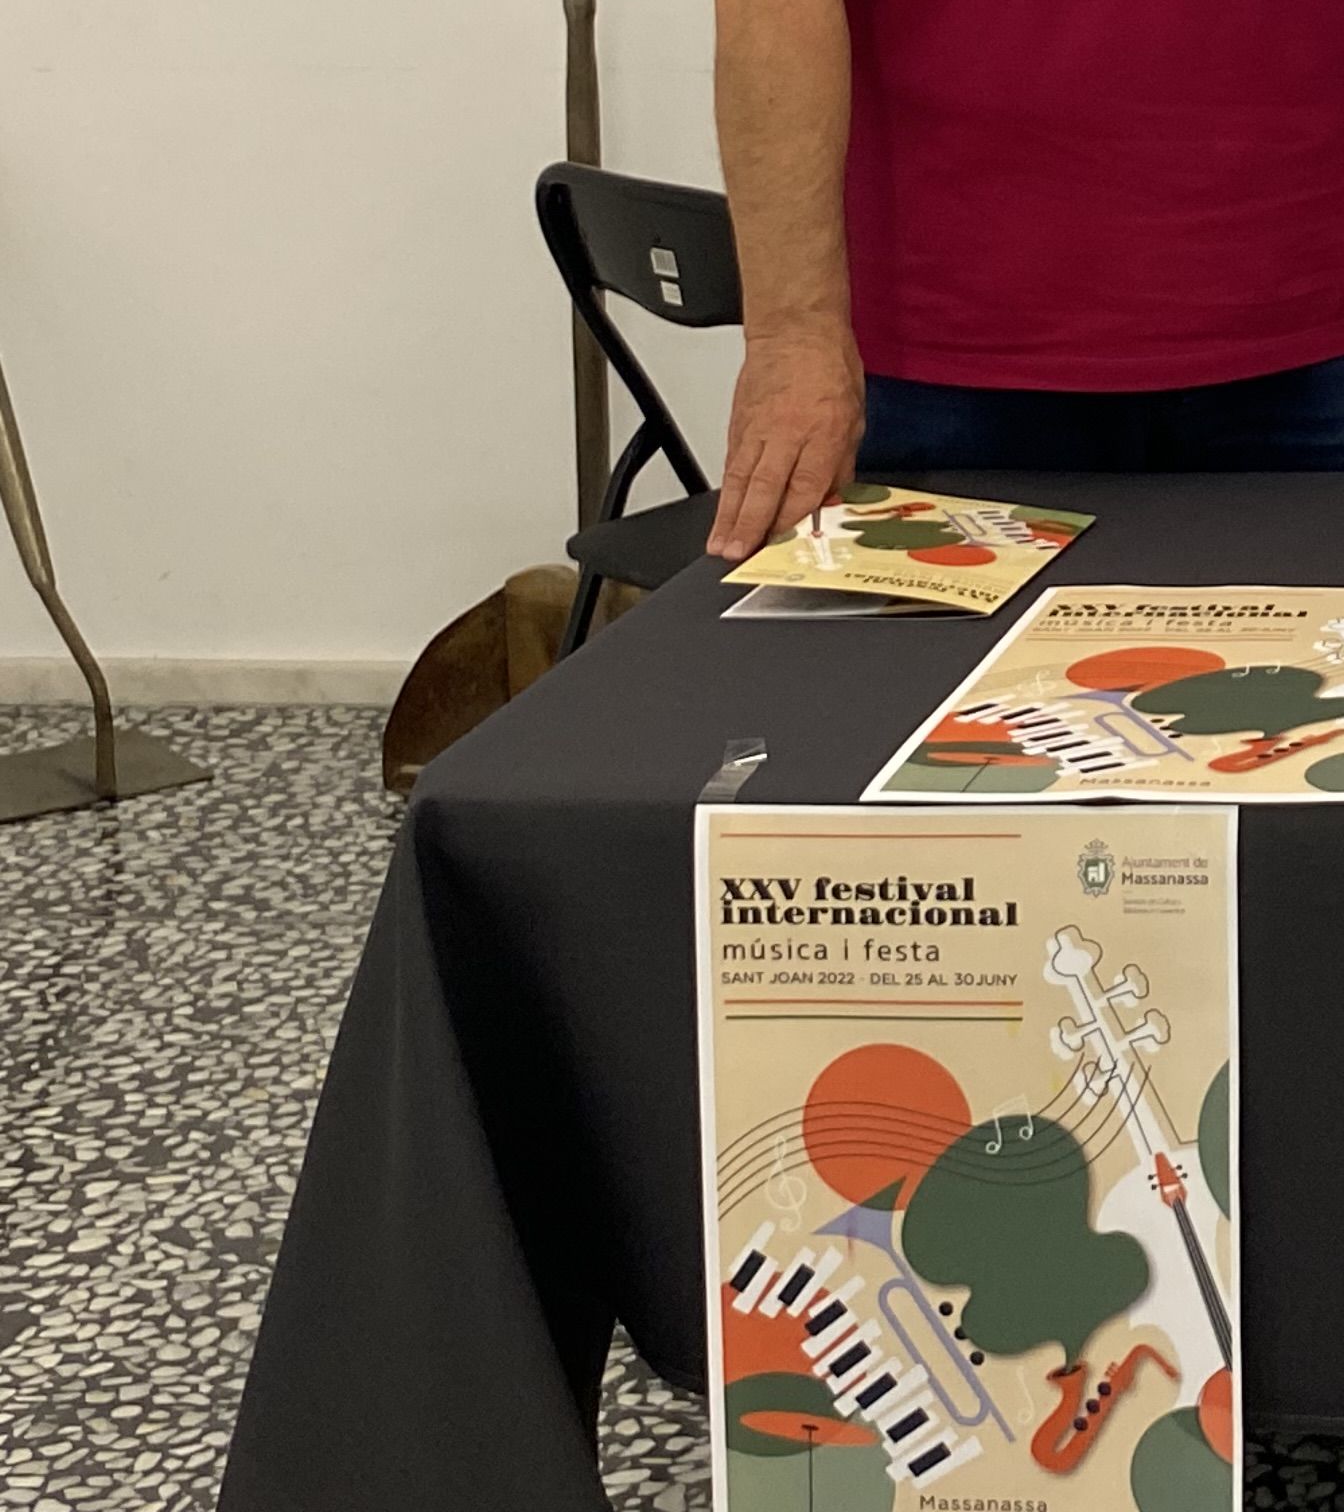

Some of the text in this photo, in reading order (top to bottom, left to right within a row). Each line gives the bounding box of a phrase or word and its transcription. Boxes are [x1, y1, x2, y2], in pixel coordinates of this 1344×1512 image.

[720, 876, 975, 902] XXV festival
[1121, 872, 1208, 885] Massanassa
[720, 899, 1018, 926] internacional
[723, 938, 940, 962] música i festa
[721, 971, 763, 985] SANT
[768, 971, 813, 985] JOAN
[817, 971, 855, 985] 2022
[870, 972, 900, 986] DEL
[904, 972, 923, 986] 25
[927, 972, 949, 986] AL
[920, 1494, 1048, 1512] Massanassa
